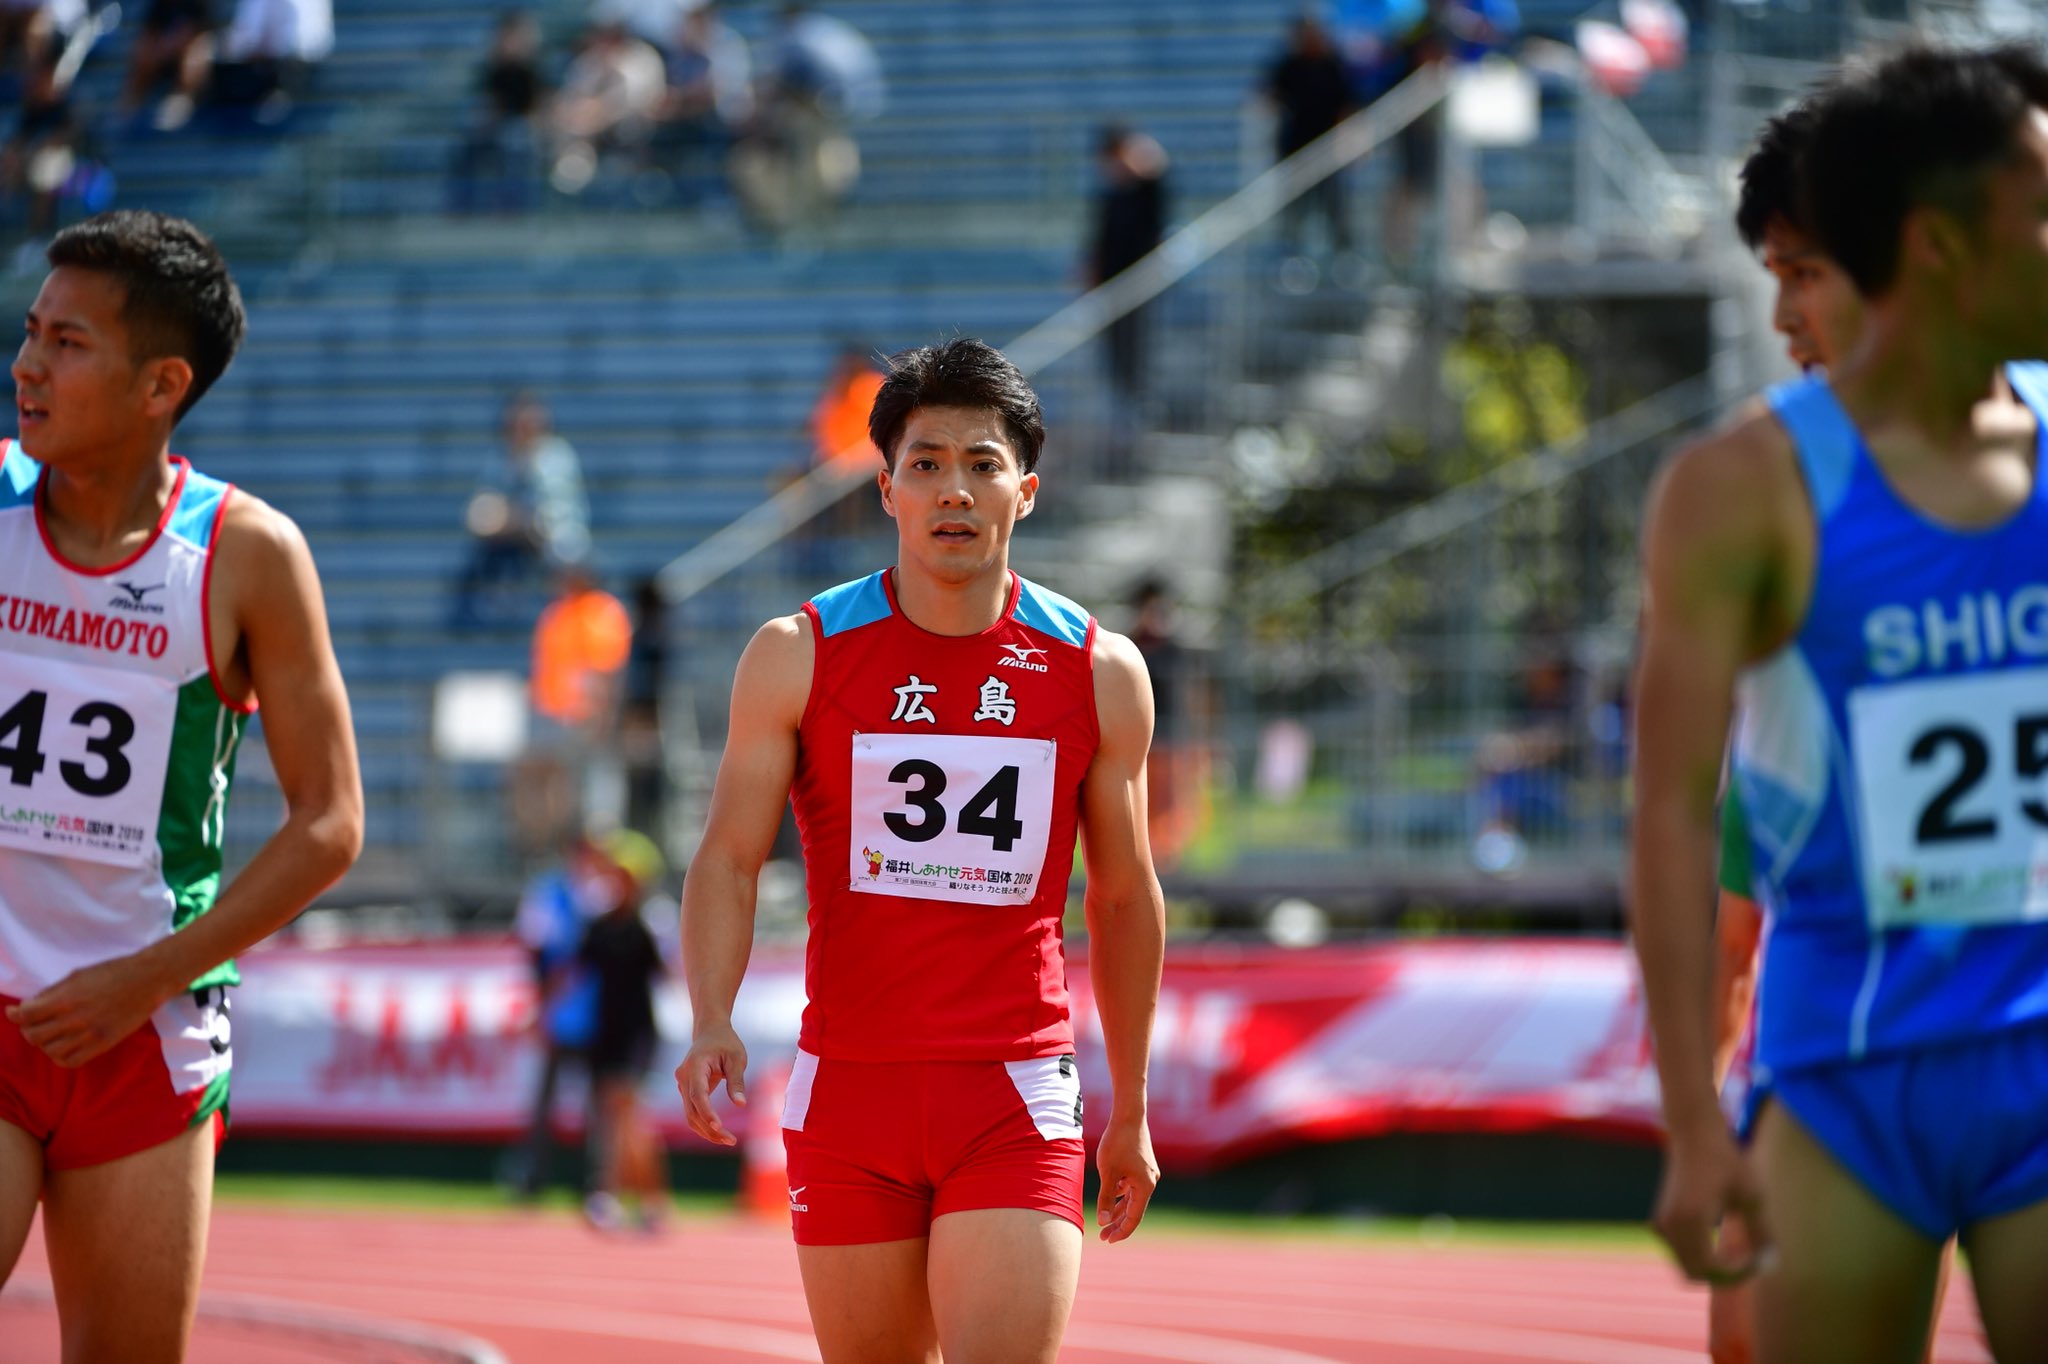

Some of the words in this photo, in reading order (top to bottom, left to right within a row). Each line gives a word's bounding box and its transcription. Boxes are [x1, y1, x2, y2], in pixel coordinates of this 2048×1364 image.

[0, 592, 169, 660] UMAMOTO
[890, 675, 1016, 726] 広島
[0, 689, 135, 799] 43
[883, 758, 1023, 852] 34
[885, 859, 1012, 884] 福井しあわせ元気国体
[1013, 872, 1033, 886] 2018
